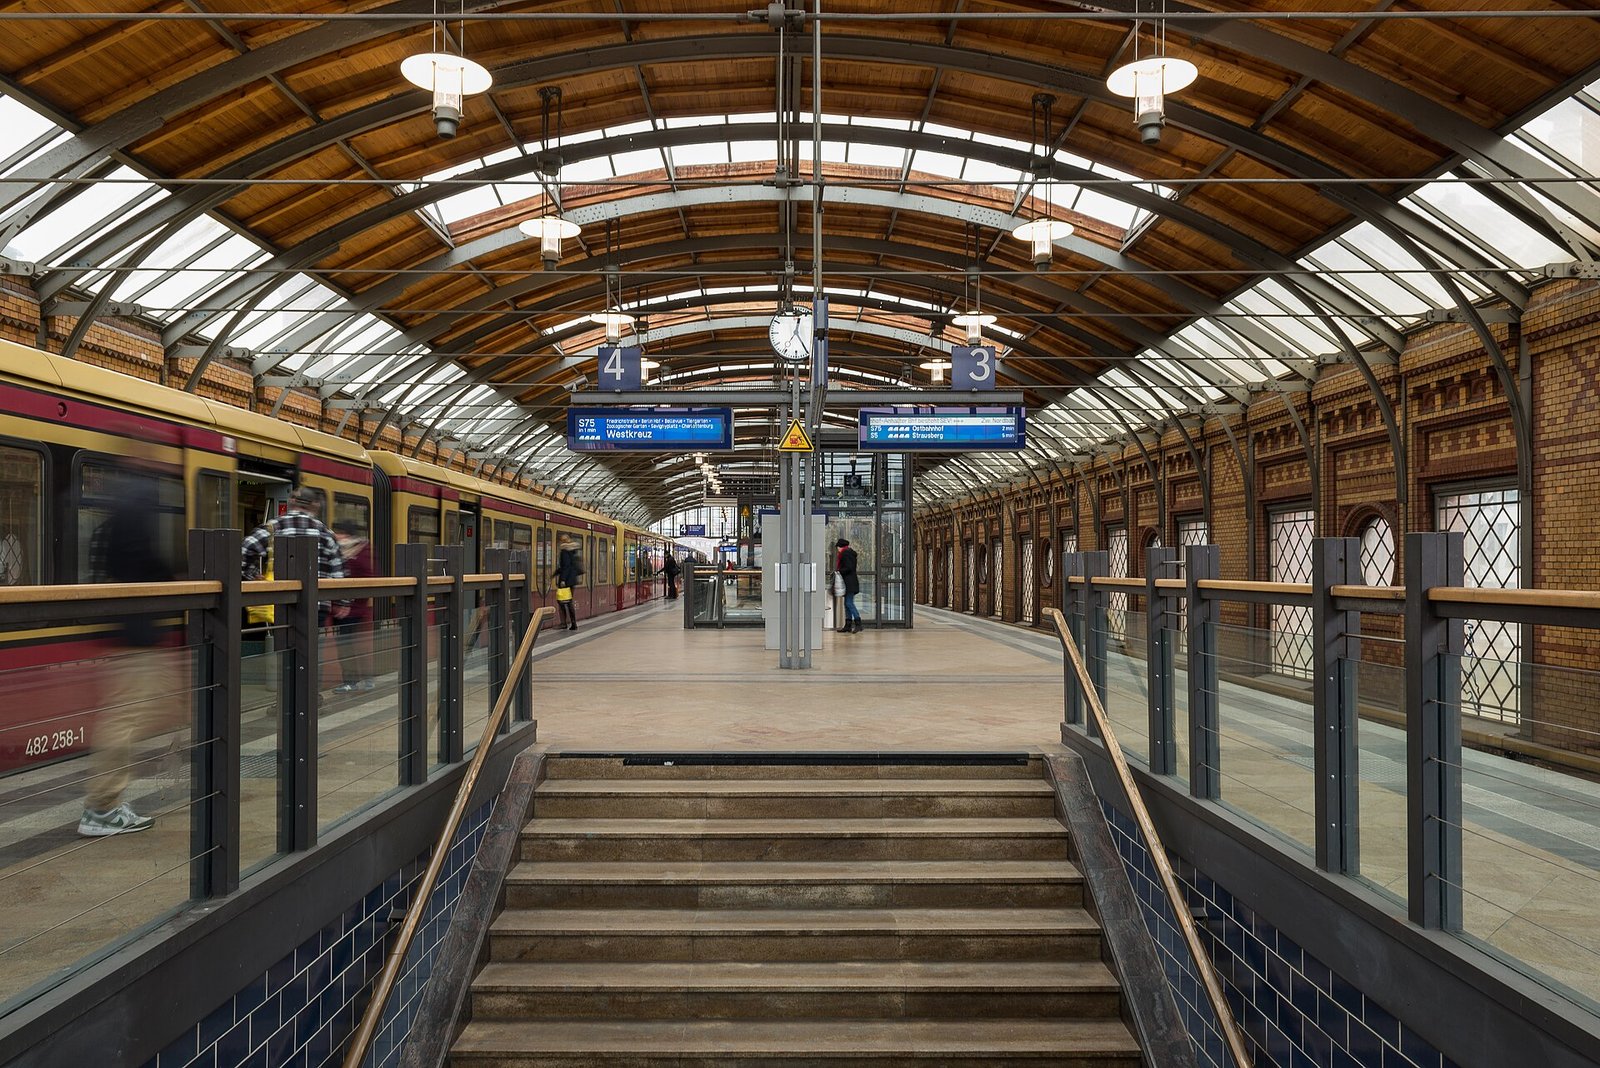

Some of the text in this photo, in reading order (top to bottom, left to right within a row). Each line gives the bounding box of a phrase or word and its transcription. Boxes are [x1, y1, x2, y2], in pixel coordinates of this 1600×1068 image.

[604, 348, 625, 381] 4
[969, 348, 990, 381] 3
[578, 418, 596, 428] S75
[606, 429, 653, 439] Westkreuz
[911, 432, 944, 440] Strausberg
[681, 524, 687, 534] 4
[25, 726, 84, 756] 482 258-1
